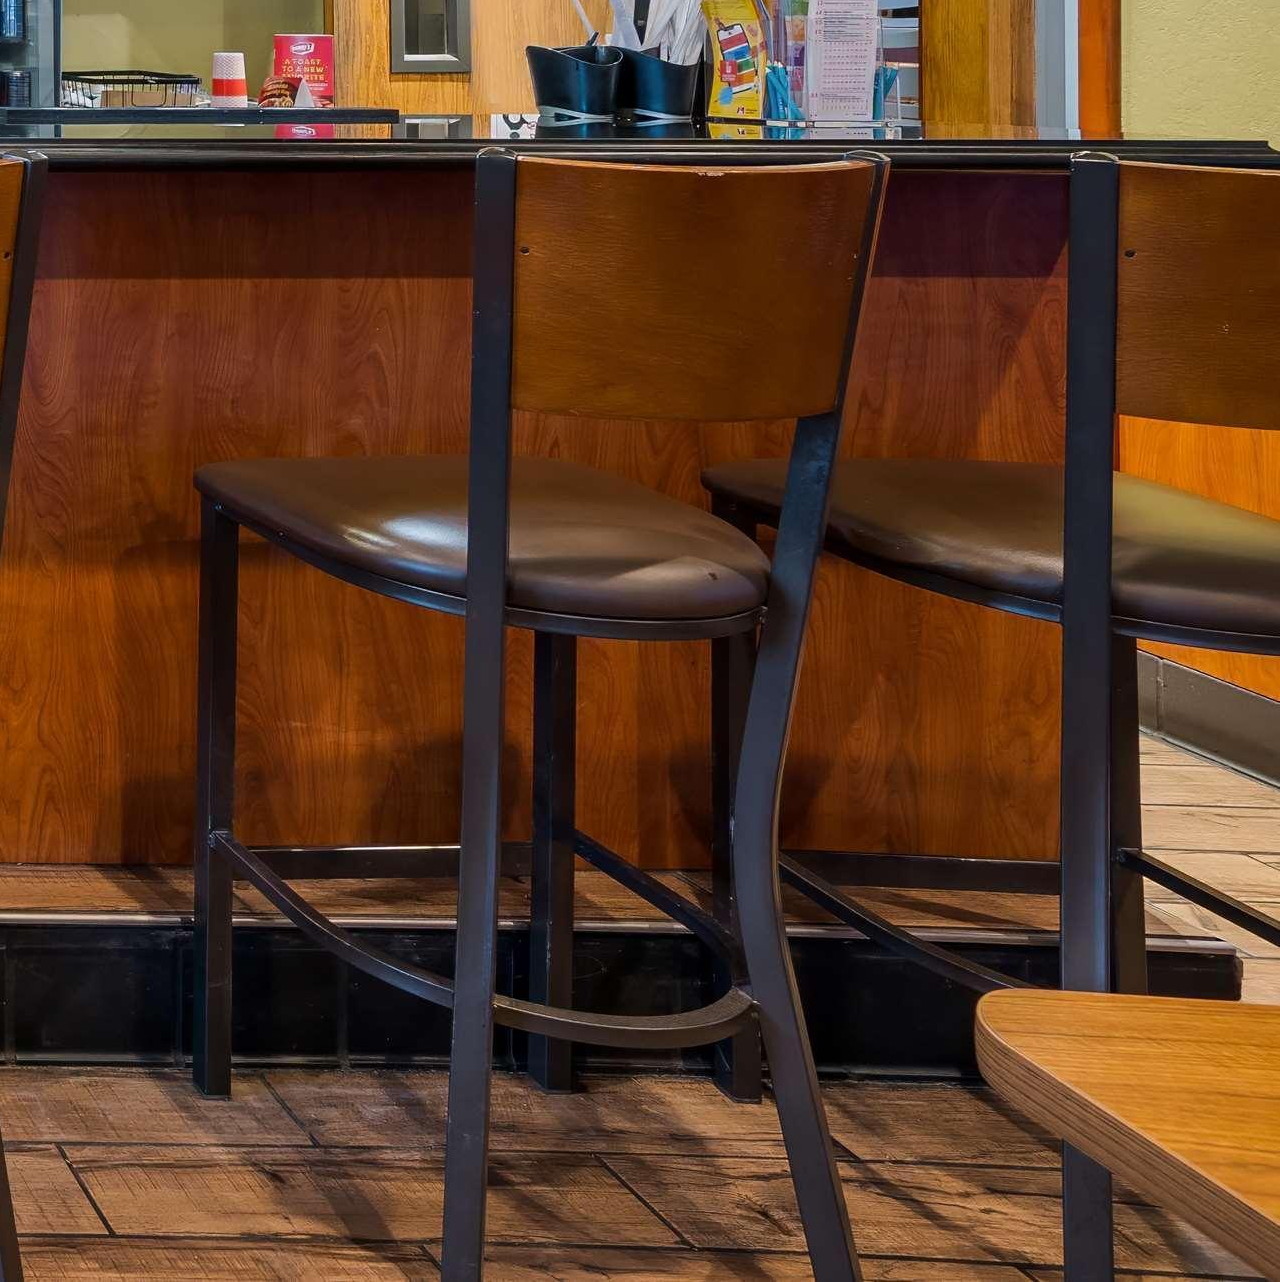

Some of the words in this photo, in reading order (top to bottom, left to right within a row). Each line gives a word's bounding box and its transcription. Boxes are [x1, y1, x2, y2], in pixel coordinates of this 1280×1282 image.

[281, 65, 294, 73] TO
[296, 65, 303, 73] A
[304, 65, 325, 73] NEW
